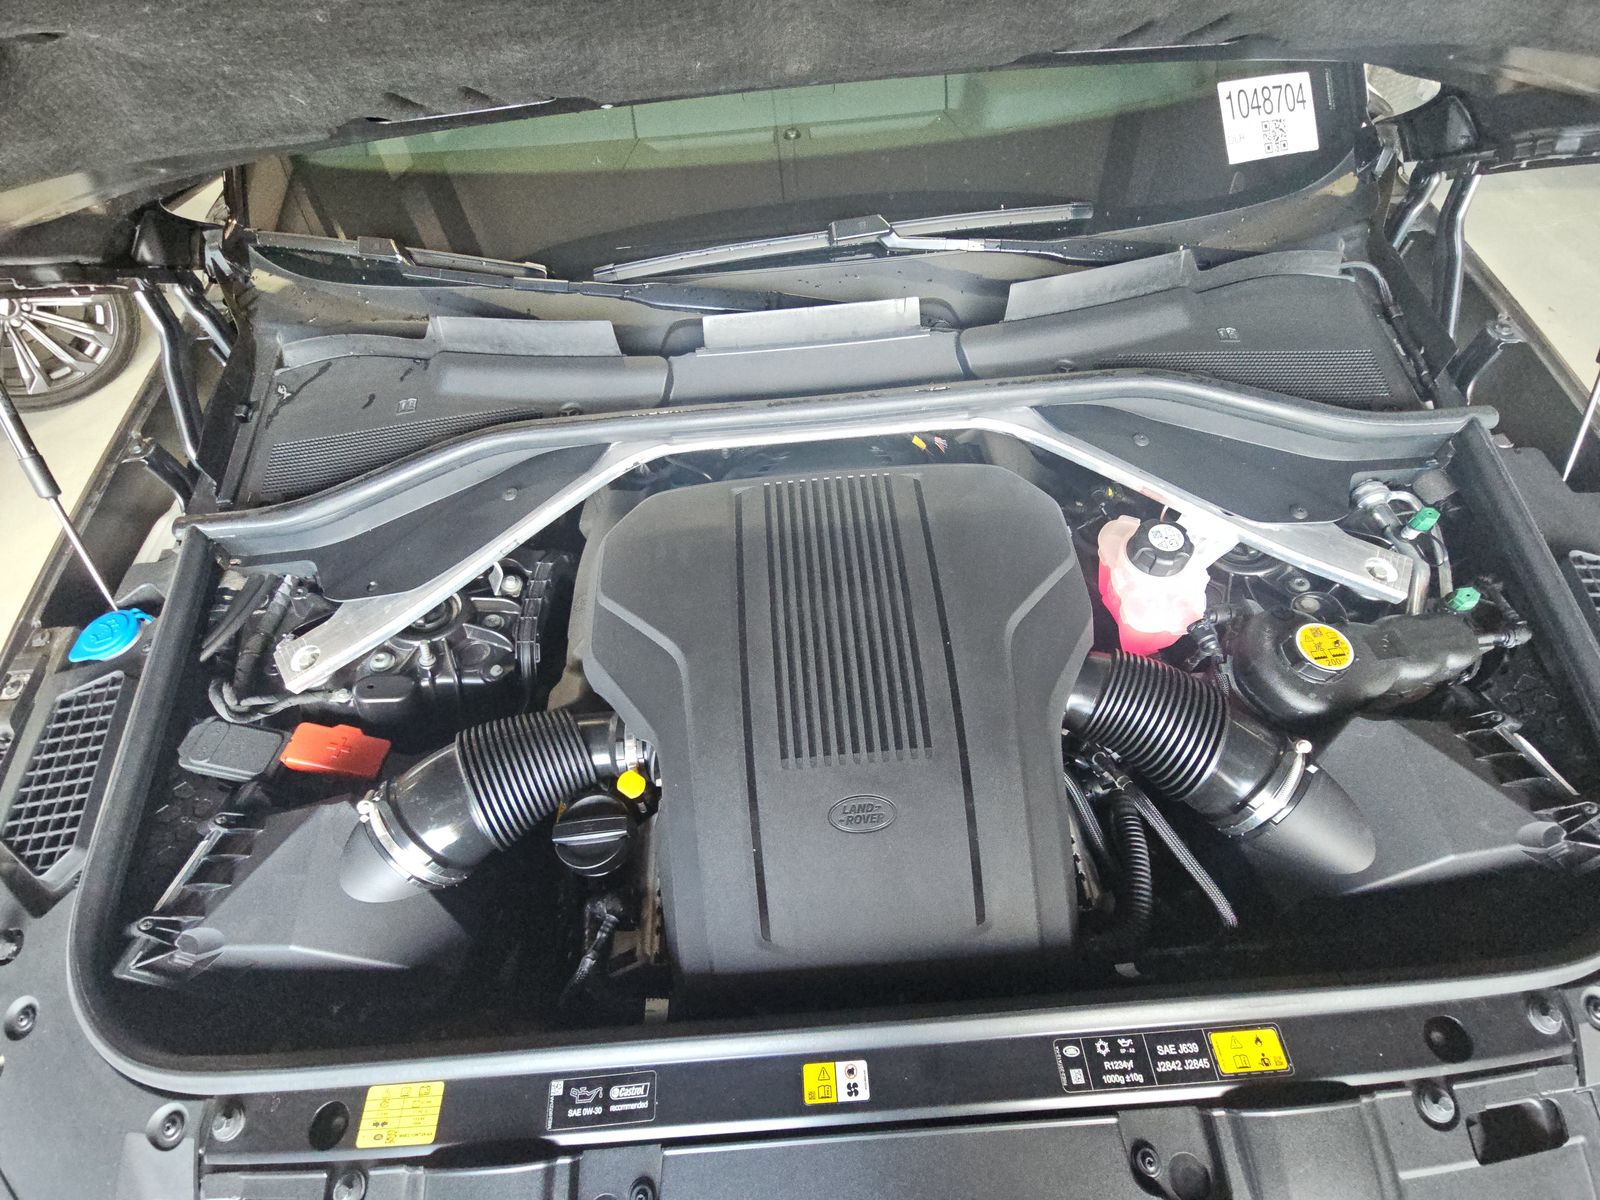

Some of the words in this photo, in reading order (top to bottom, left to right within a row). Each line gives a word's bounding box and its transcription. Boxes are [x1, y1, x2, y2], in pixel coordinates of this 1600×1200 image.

[1226, 83, 1307, 121] 1048704
[1156, 1044, 1178, 1056] SAE
[1178, 1042, 1200, 1054] J639
[1104, 1060, 1134, 1071] R1234yf
[1156, 1060, 1182, 1072] J2842
[1183, 1058, 1211, 1070] J2845
[1102, 1075, 1126, 1086] 1000g
[618, 1086, 645, 1097] Castrol
[609, 1101, 649, 1112] recommended
[567, 1108, 582, 1117] SAE
